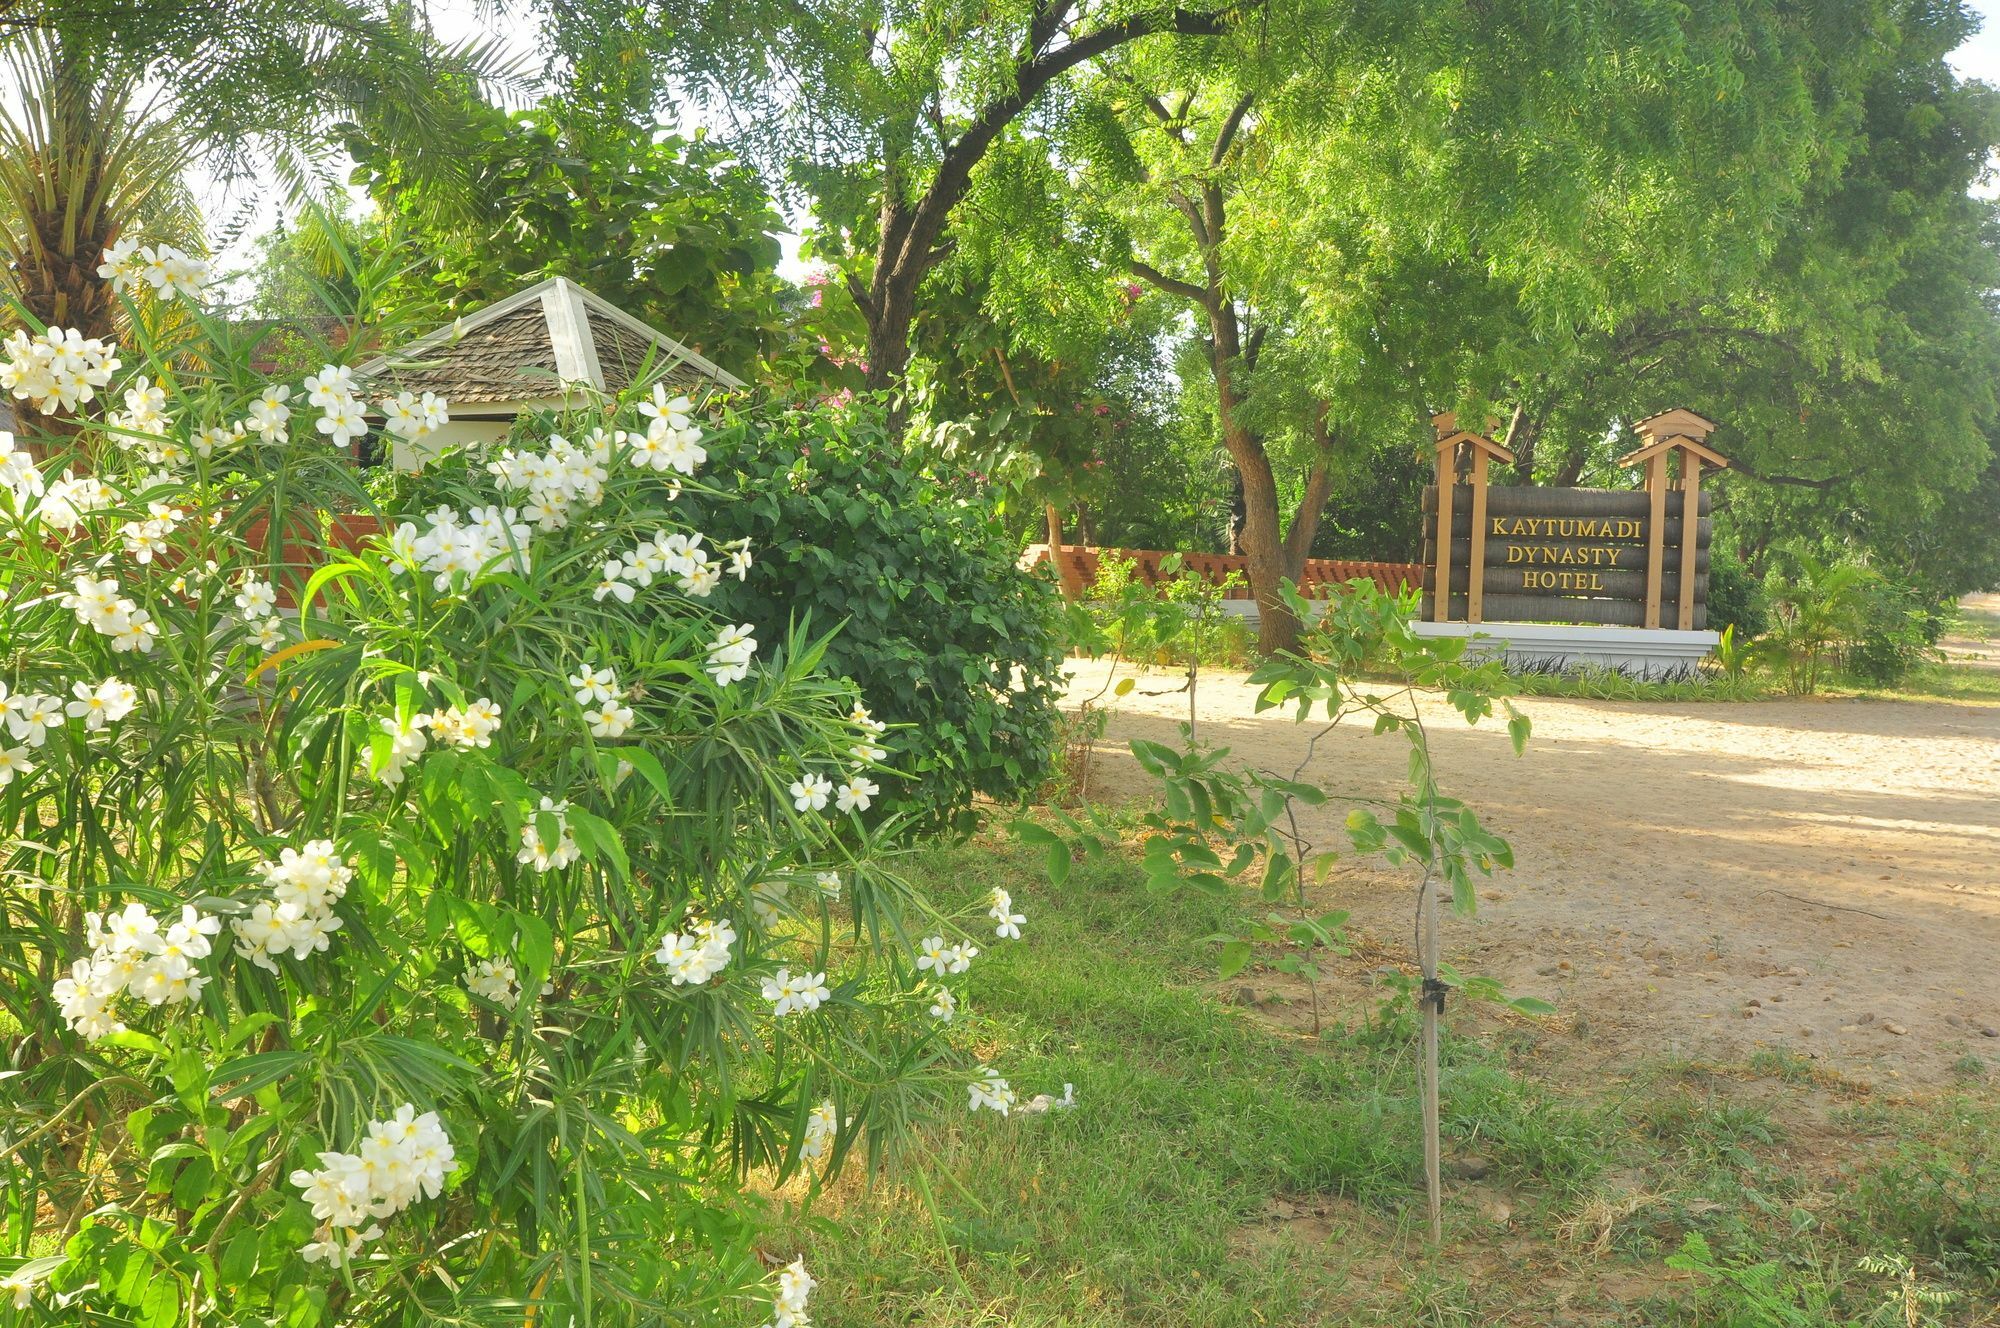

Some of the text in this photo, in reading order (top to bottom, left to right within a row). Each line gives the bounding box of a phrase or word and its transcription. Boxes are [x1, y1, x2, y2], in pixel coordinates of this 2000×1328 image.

[1492, 518, 1642, 538] KAYTUMADI
[1507, 546, 1622, 566] DYNASTY
[1523, 571, 1604, 591] HOTEL
